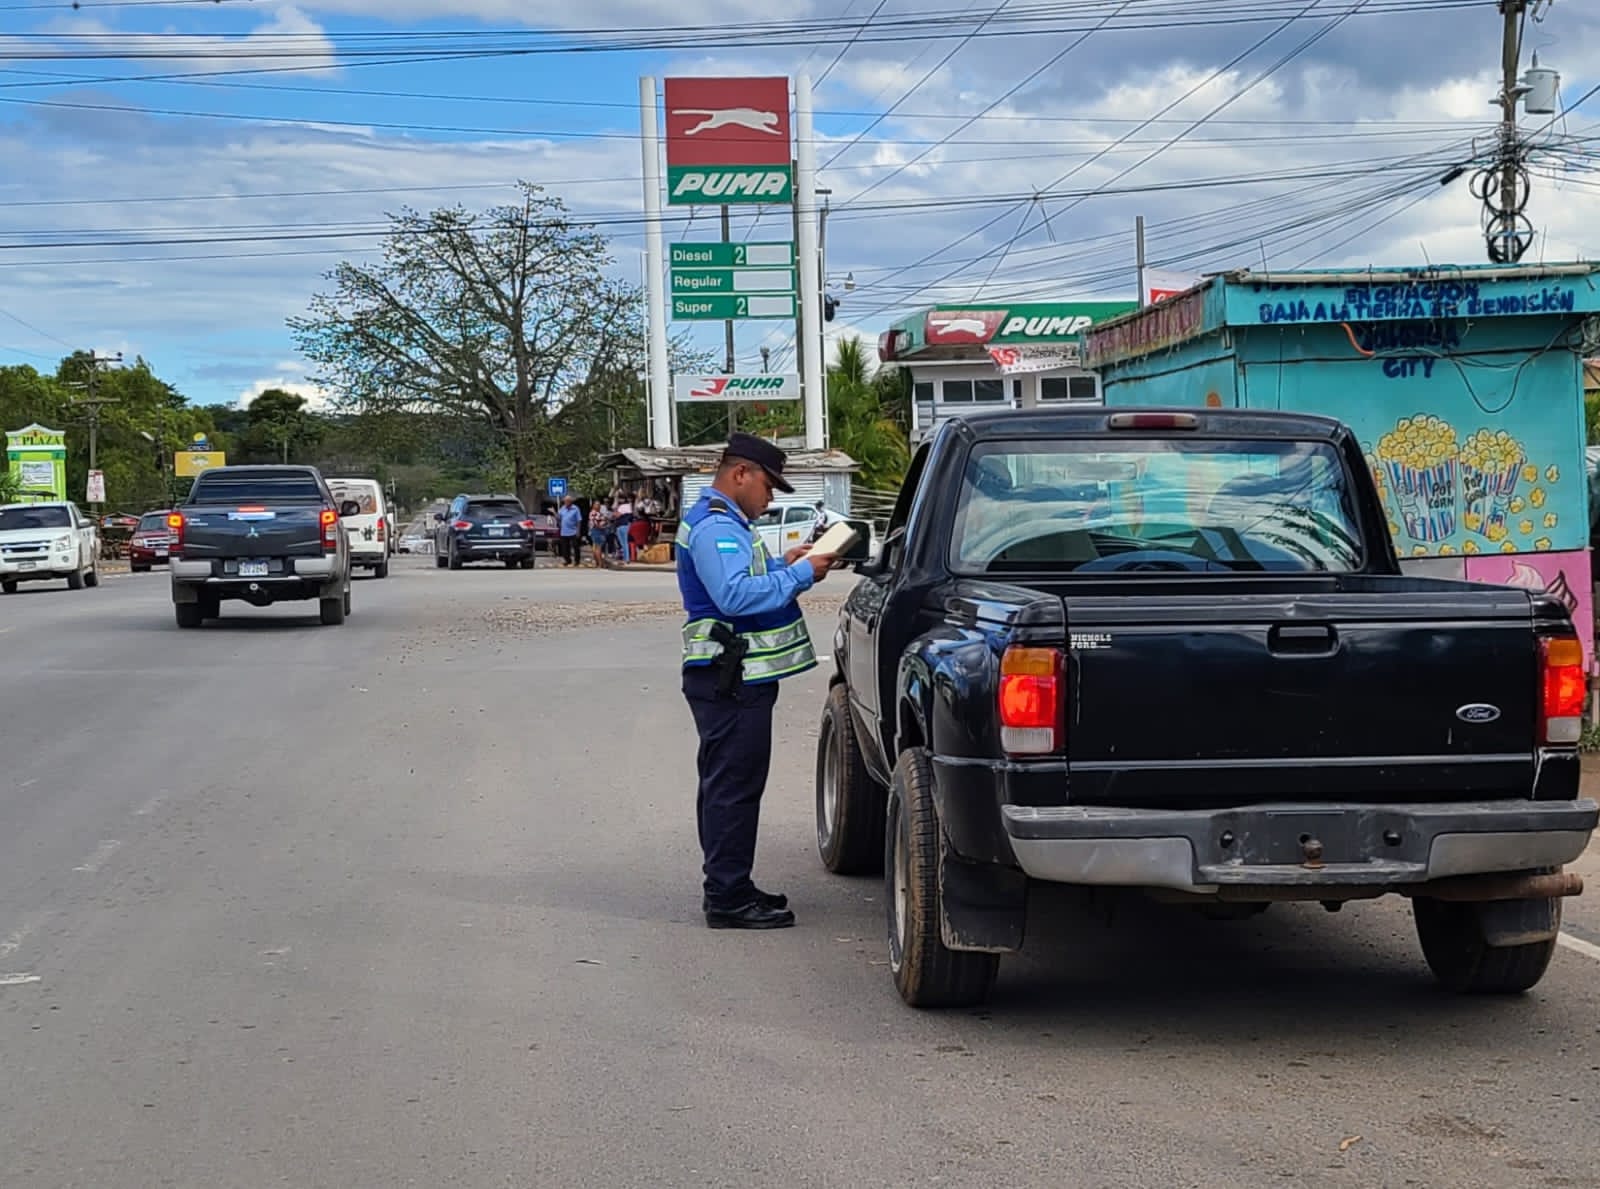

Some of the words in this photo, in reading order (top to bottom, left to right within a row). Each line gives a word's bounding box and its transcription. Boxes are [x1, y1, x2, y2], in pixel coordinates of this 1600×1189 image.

[672, 173, 788, 196] PUMA
[673, 250, 713, 261] Diesel
[734, 246, 745, 264] 2
[674, 275, 723, 289] Regular
[675, 301, 713, 315] Super
[736, 297, 747, 315] 2
[1313, 302, 1328, 321] A
[1382, 357, 1435, 378] CITY
[726, 377, 785, 390] PUMA
